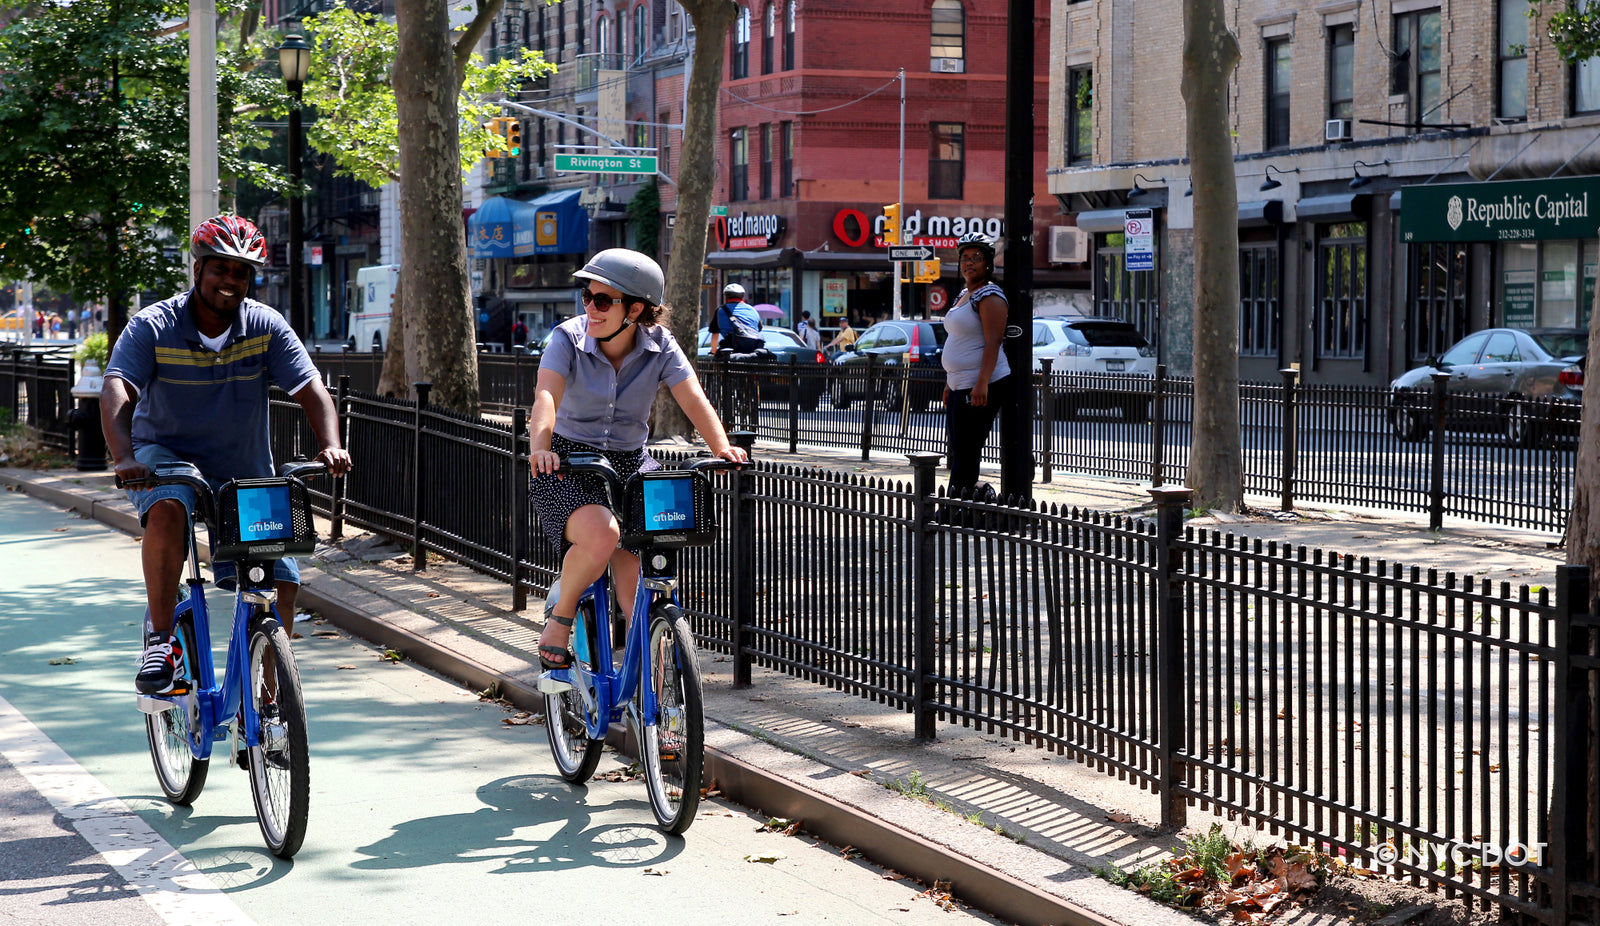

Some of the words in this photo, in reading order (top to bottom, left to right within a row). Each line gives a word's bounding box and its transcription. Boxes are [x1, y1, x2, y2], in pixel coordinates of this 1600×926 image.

[570, 157, 622, 169] Rivington
[629, 158, 642, 168] St
[1466, 195, 1531, 227] Republic
[1535, 192, 1589, 225] Capital
[727, 211, 744, 236] red
[745, 214, 778, 240] mango
[874, 209, 921, 236] rd
[927, 216, 1005, 242] mang
[1498, 229, 1535, 239] 212-228-3134
[1404, 232, 1413, 241] 149
